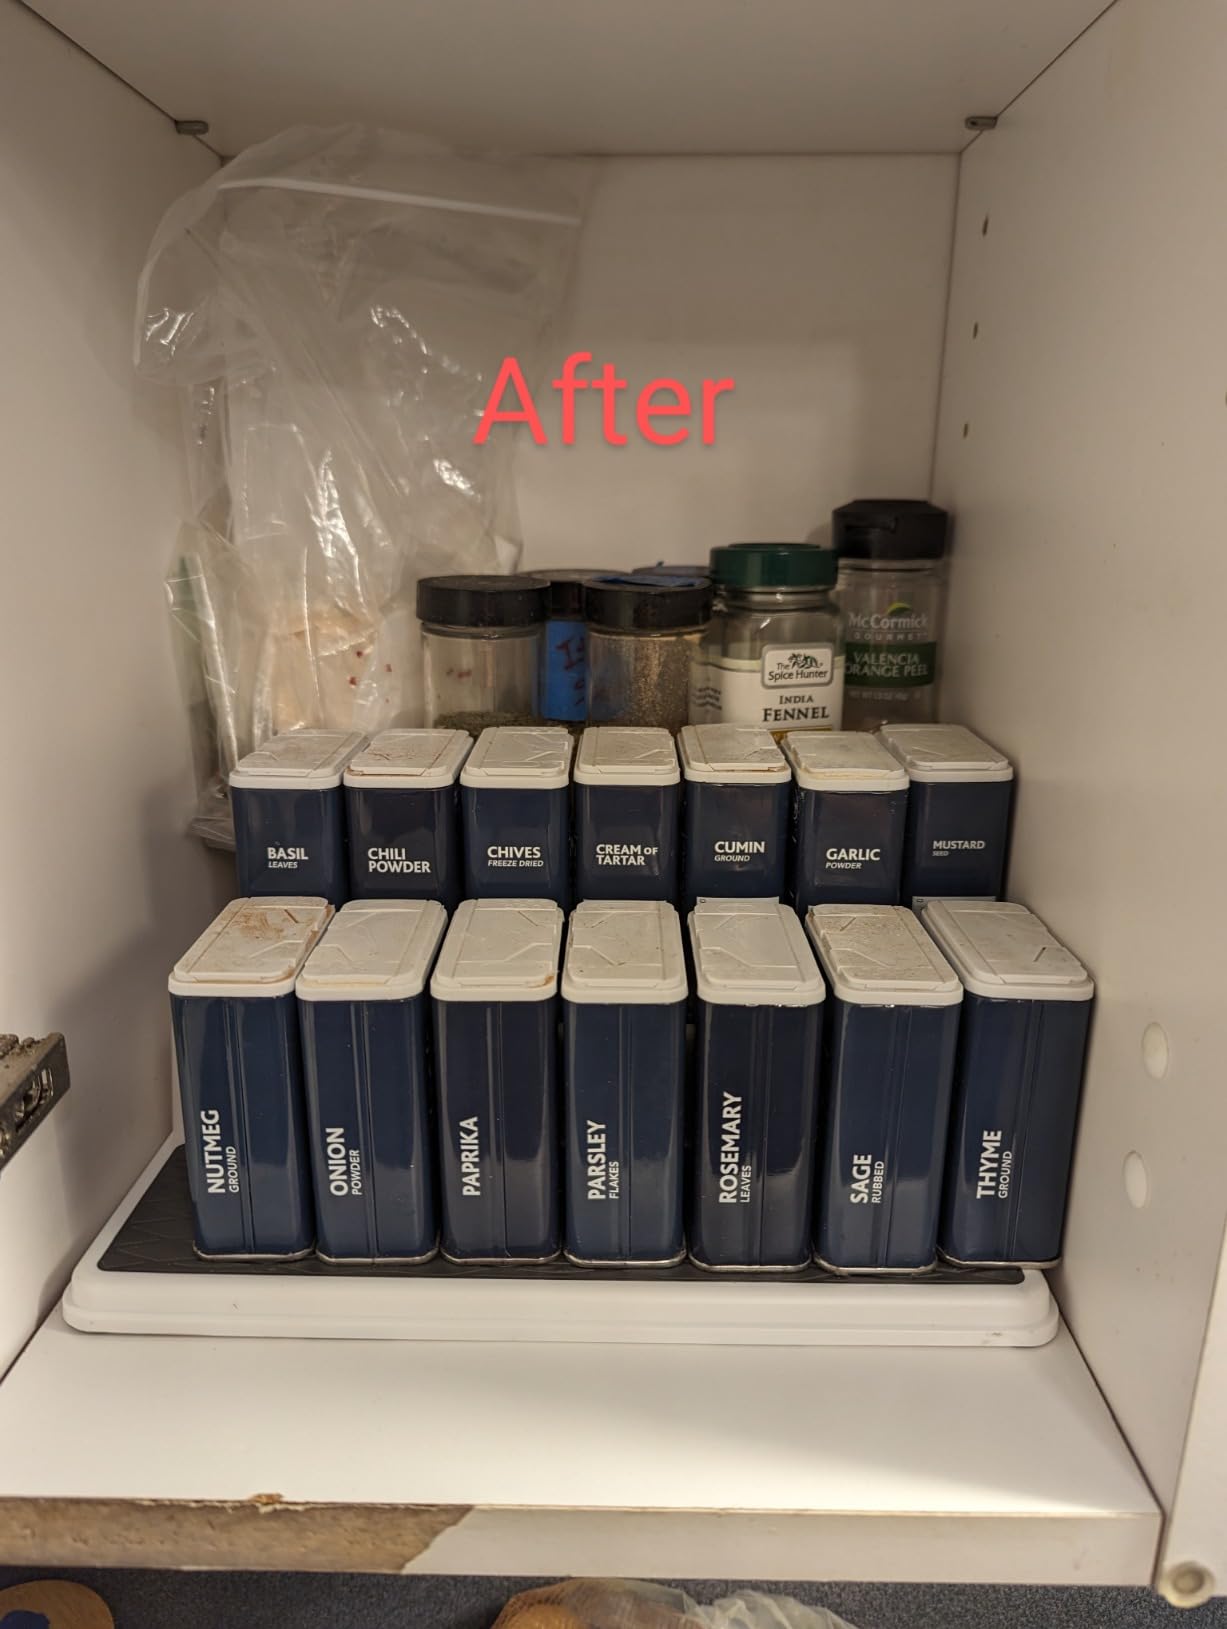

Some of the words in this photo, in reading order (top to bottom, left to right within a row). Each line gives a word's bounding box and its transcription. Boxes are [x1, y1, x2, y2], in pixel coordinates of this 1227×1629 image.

[848, 613, 929, 630] McCormick
[853, 652, 921, 666] VALENCIA
[776, 662, 792, 671] The
[904, 664, 929, 677] PEEL
[768, 671, 794, 683] Spice
[795, 670, 829, 680] Hunter
[779, 695, 814, 705] INDIA
[762, 706, 830, 722] FENNEL
[596, 844, 641, 855] CREAM
[714, 841, 765, 854] CUMIN
[932, 840, 986, 850] MUSTARD
[267, 847, 309, 861] BASIL
[367, 847, 406, 861] CHILI
[487, 846, 541, 859] CHIVES
[714, 854, 751, 863] GROUND
[826, 847, 881, 863] GARLIC
[268, 861, 298, 870] LEAVES
[368, 860, 431, 874] POWDER
[487, 859, 519, 868] FREEZE
[520, 859, 544, 868] DRIED
[597, 854, 645, 867] TARTAR
[825, 862, 863, 870] POWDER
[200, 1109, 226, 1194] NUTMEG
[718, 1091, 742, 1204] ROSEMARY
[326, 1127, 348, 1196] ONION
[459, 1116, 481, 1197] PAPRIKA
[587, 1120, 607, 1200] PARSLEY
[226, 1145, 240, 1193] GROUND
[975, 1129, 1002, 1199] THYME
[351, 1148, 363, 1196] POWDER
[849, 1153, 873, 1204] SAGE
[998, 1150, 1013, 1199] GROUND
[608, 1160, 620, 1200] FLAKES
[740, 1164, 752, 1203] LEAVES
[871, 1160, 885, 1204] RUBBED
